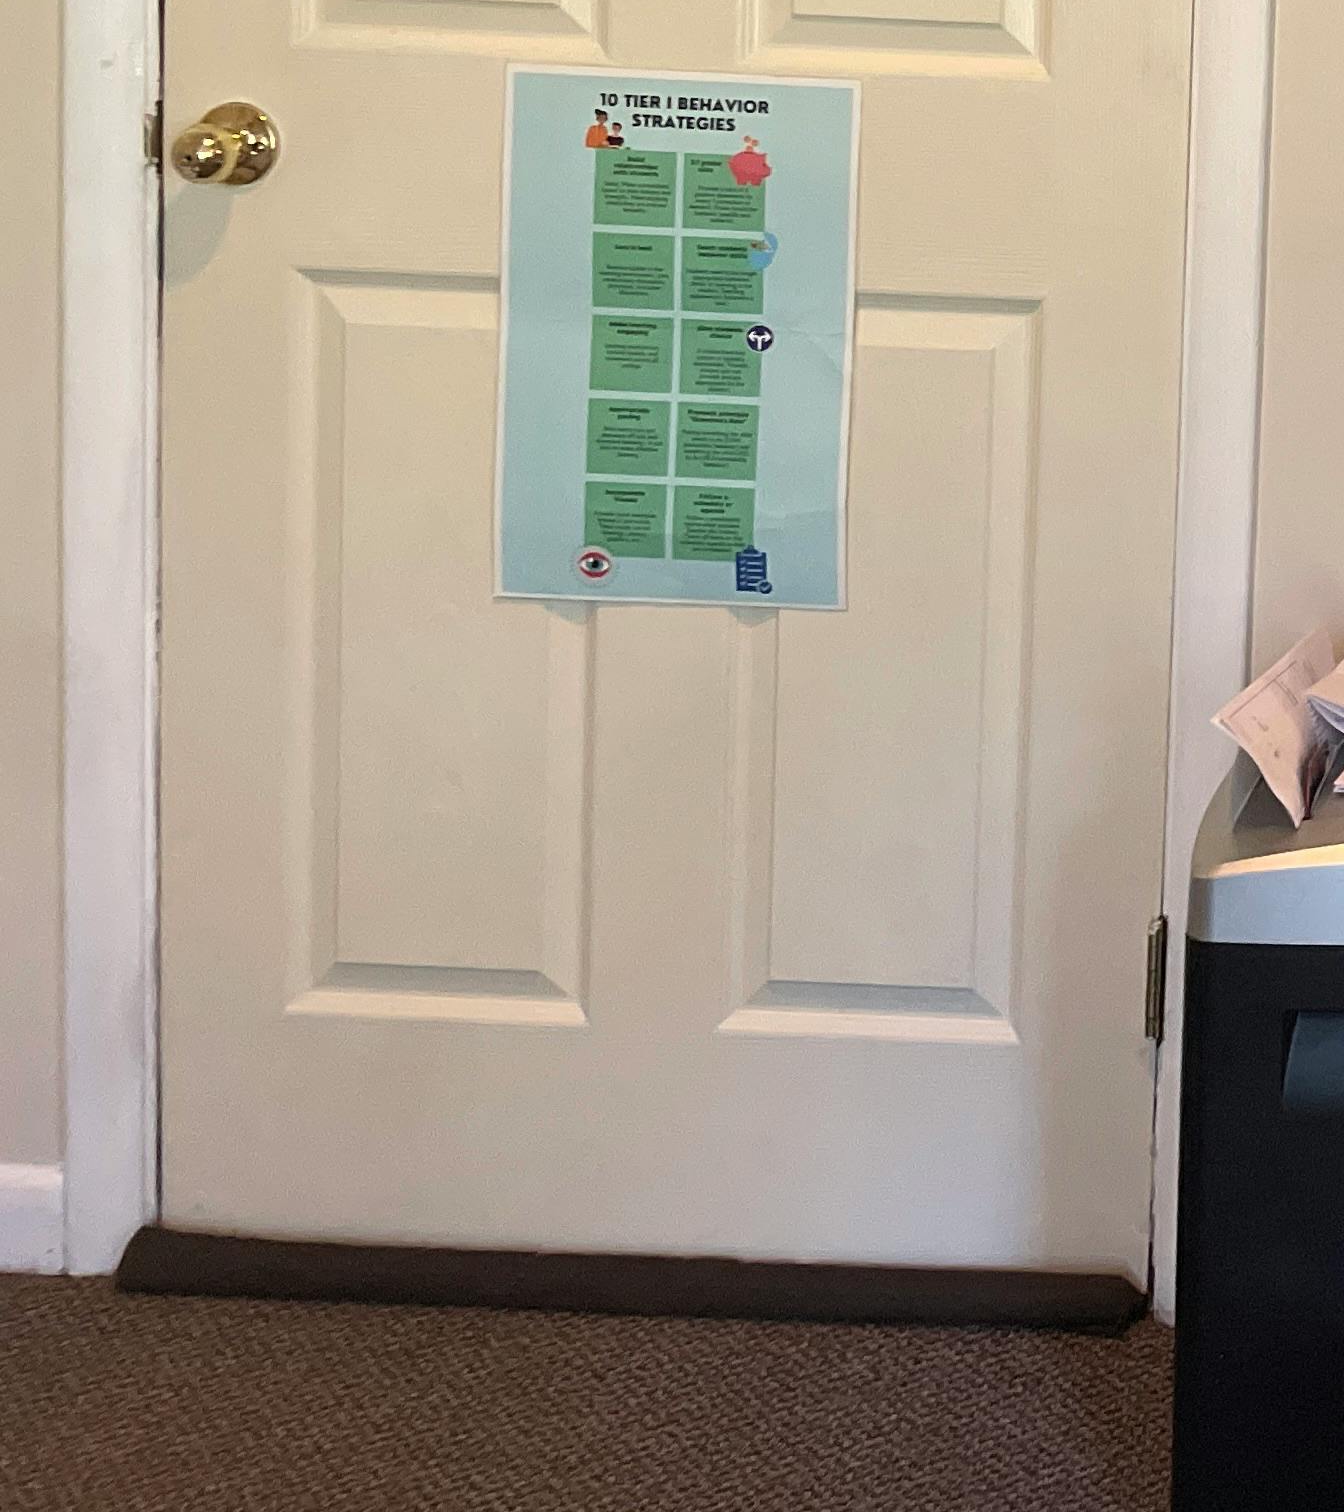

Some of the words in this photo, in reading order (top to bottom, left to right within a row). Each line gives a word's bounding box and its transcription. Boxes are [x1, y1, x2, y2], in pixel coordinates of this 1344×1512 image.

[600, 93, 618, 106] 10
[624, 94, 660, 108] TIER
[667, 97, 671, 105] I
[678, 97, 769, 114] BEHAVIOR
[632, 114, 736, 131] STRATEGIES
